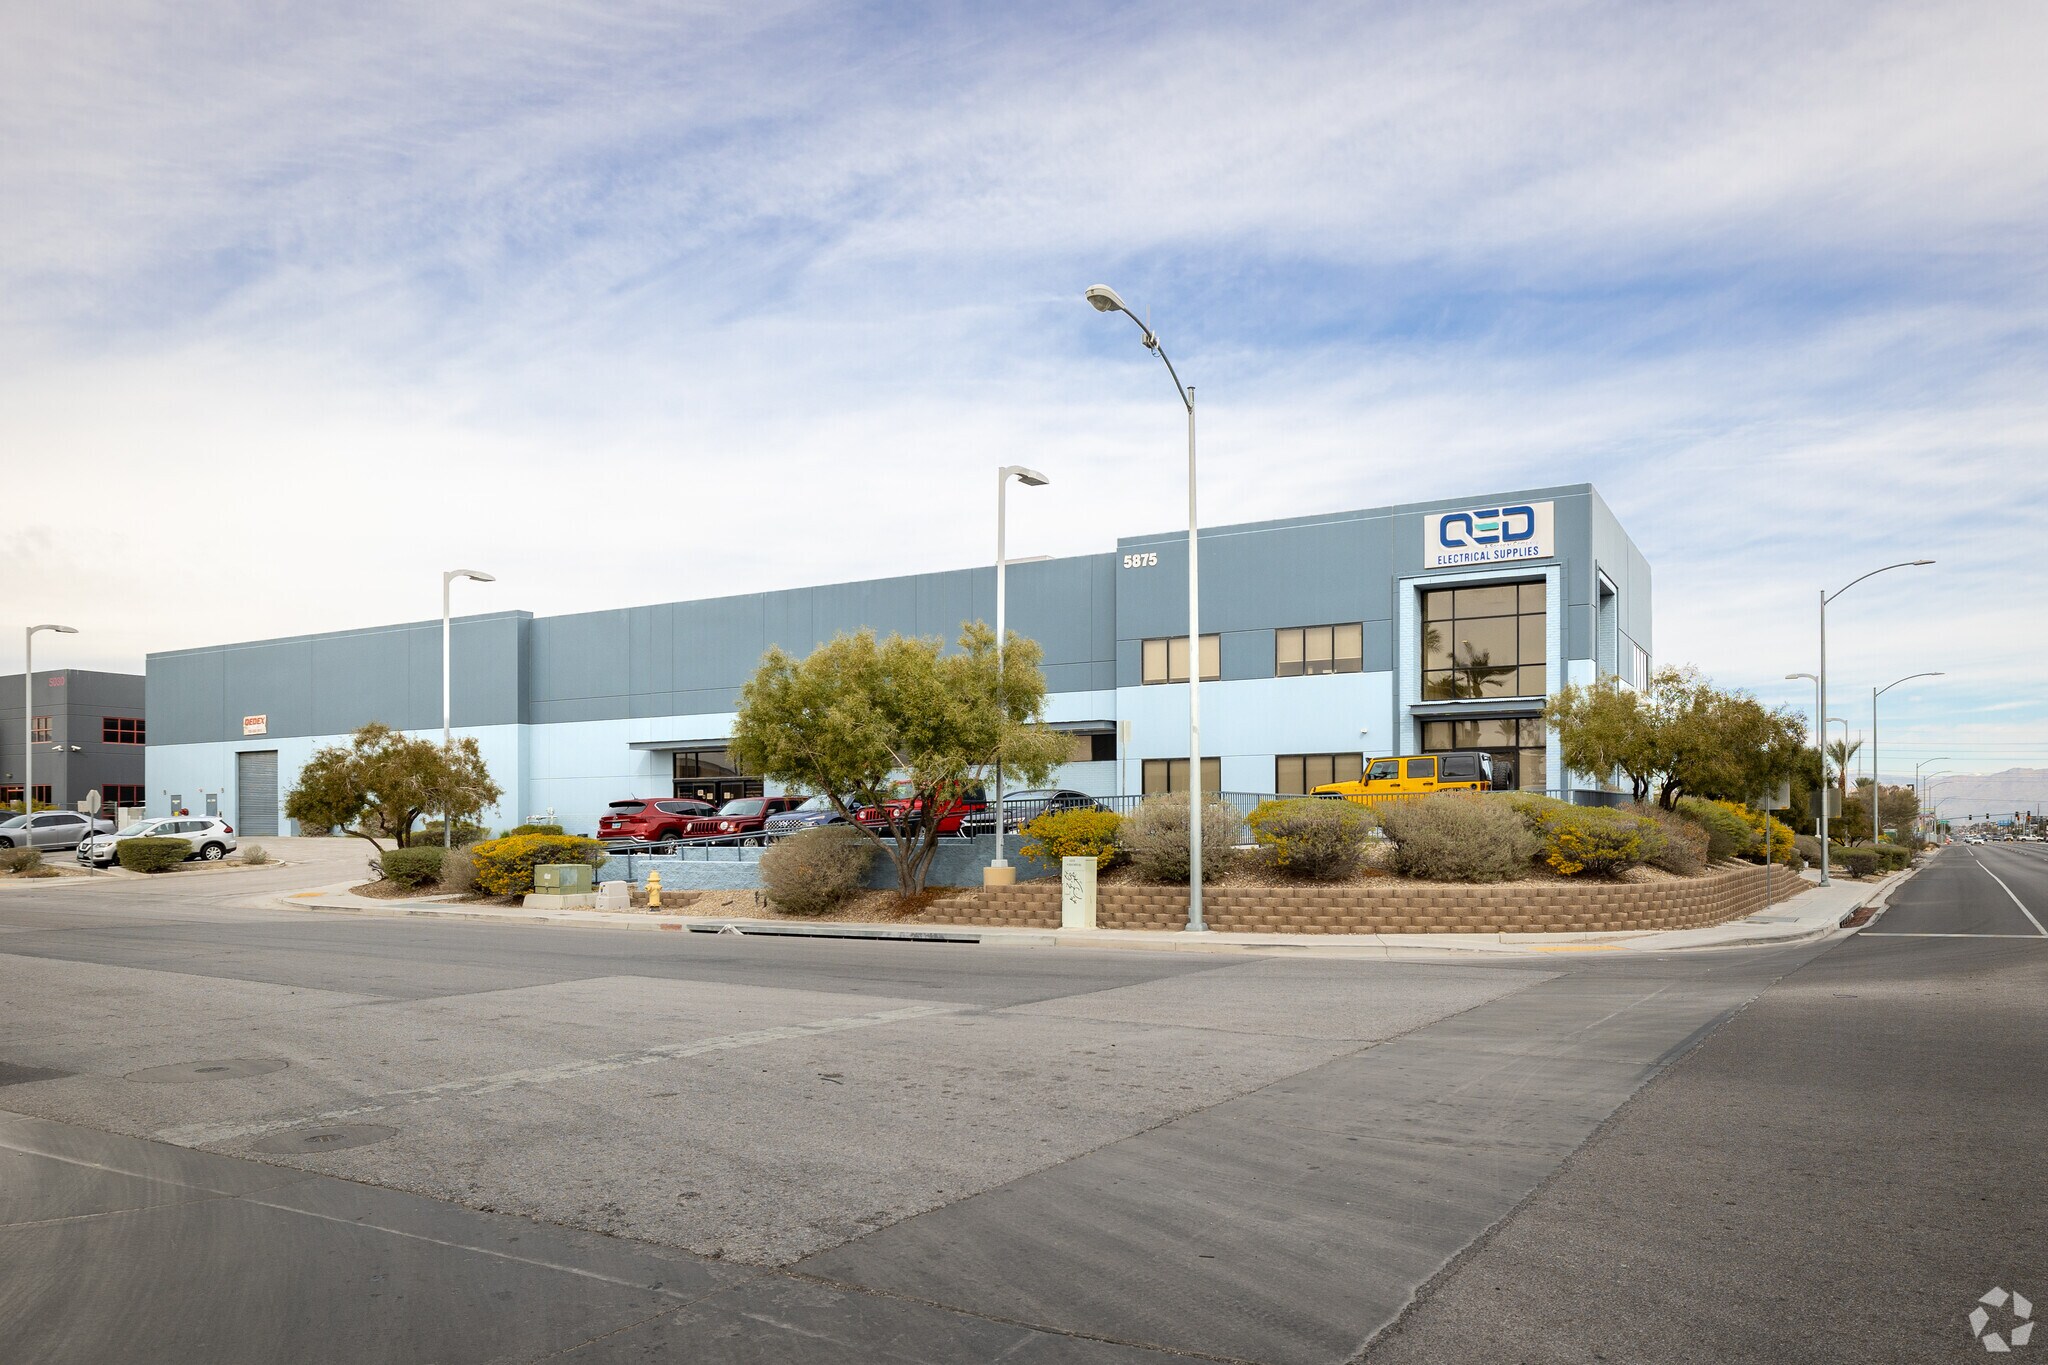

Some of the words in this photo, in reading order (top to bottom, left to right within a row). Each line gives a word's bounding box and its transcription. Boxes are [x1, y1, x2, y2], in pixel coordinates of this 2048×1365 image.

[1440, 506, 1534, 548] QED
[1123, 552, 1158, 569] 5875
[1438, 551, 1490, 565] ELECTRICAL
[1494, 546, 1539, 559] SUPPLIES
